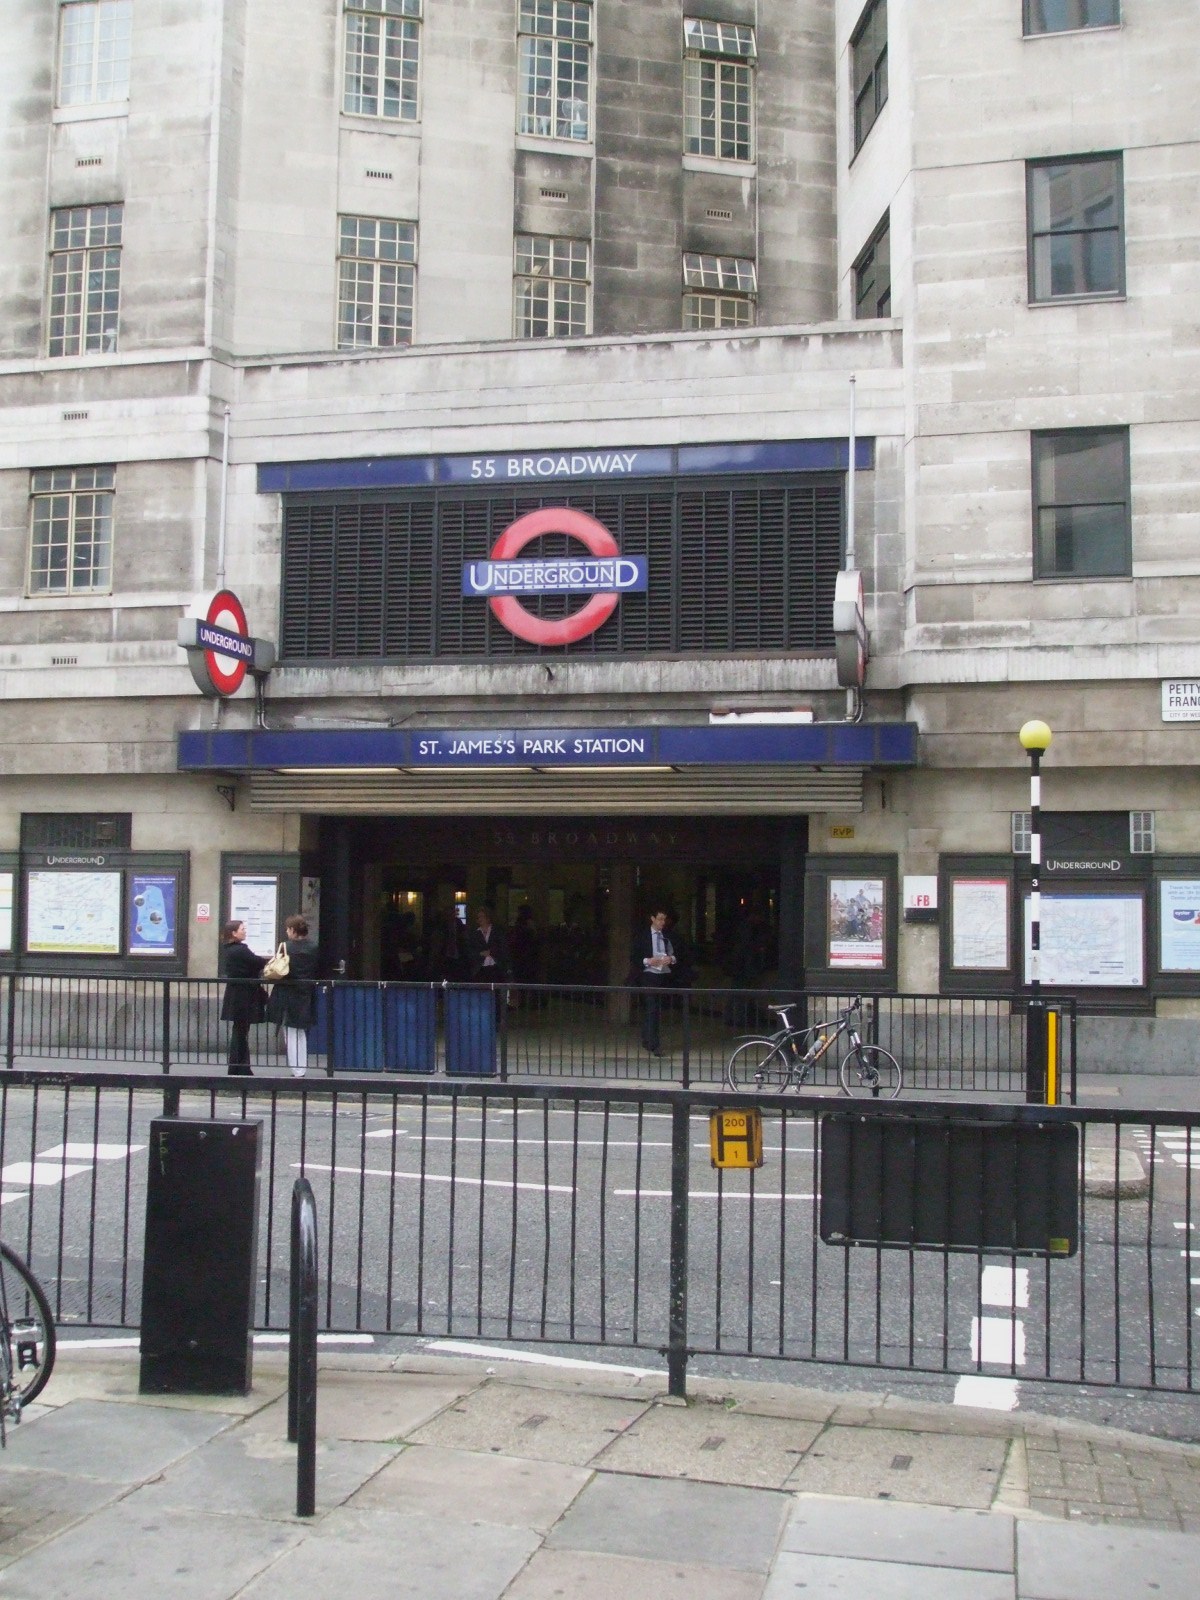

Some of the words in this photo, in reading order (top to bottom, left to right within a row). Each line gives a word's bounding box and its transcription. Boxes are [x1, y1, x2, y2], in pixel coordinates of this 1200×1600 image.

[470, 459, 496, 478] 55
[507, 453, 638, 477] BROADWAY
[470, 560, 639, 591] UNDERGROUND
[201, 628, 252, 656] UNDERGROUND
[419, 740, 442, 755] ST.
[448, 740, 516, 755] JAMES'S
[523, 739, 567, 754] PARK
[573, 738, 644, 754] STATION
[47, 855, 105, 866] UNDERGROUND
[1046, 860, 1121, 871] UNDERGROUND
[1031, 879, 1038, 887] 3
[724, 1118, 745, 1127] 200
[733, 1150, 739, 1159] 1
